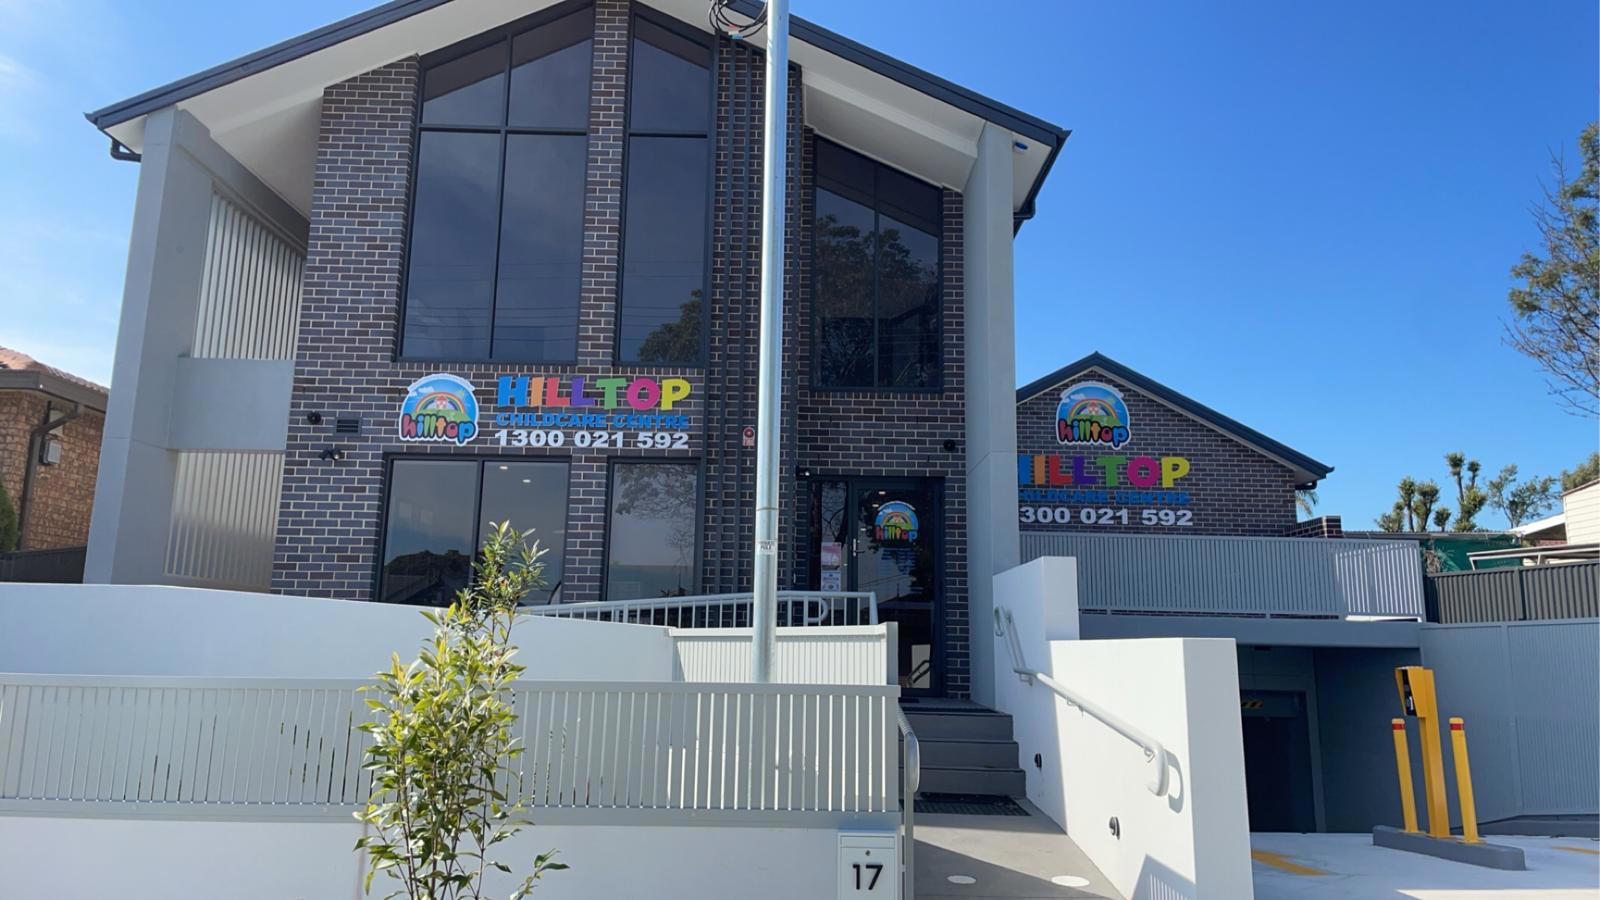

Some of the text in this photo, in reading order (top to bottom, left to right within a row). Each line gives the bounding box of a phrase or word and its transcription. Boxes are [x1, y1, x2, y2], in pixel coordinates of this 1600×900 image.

[497, 376, 691, 410] HILLTOP
[402, 413, 475, 443] hilltop
[496, 413, 689, 429] CHILDCARE CENTRE
[494, 430, 689, 448] 1300 021 592
[1058, 418, 1130, 447] hilltop
[1115, 491, 1191, 505] CENTRE
[1019, 506, 1193, 526] 300 021 592
[875, 525, 918, 542] hilltop
[852, 864, 883, 890] 17
